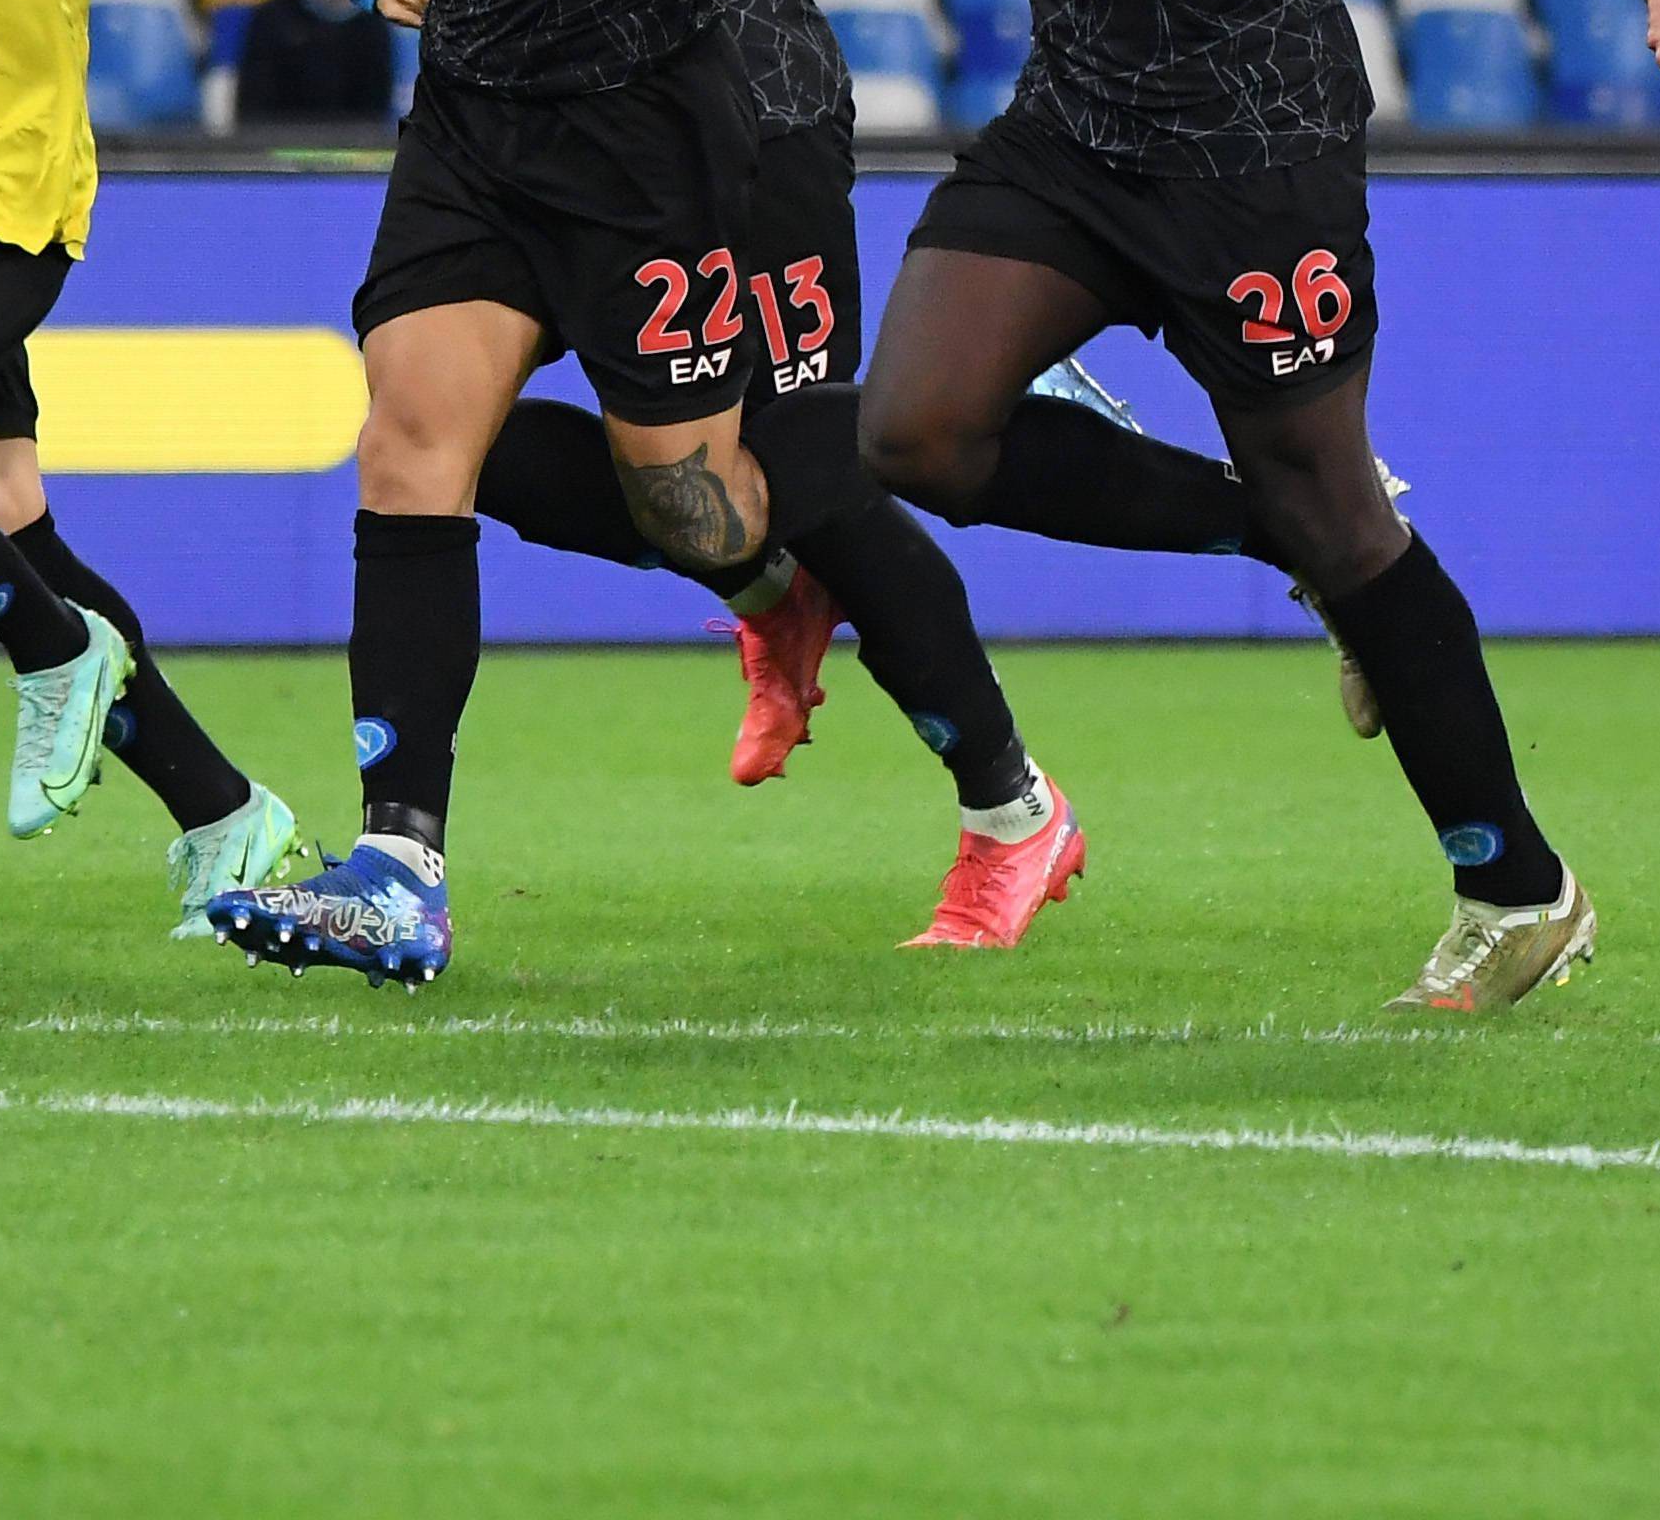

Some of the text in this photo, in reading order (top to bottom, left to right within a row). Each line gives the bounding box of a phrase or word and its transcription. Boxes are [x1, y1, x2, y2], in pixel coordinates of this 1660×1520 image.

[635, 248, 743, 355] 22
[749, 255, 835, 365] 13
[1227, 249, 1351, 343] 26
[670, 348, 732, 385] EA7
[773, 349, 828, 395] EA7
[1271, 338, 1335, 376] EA7
